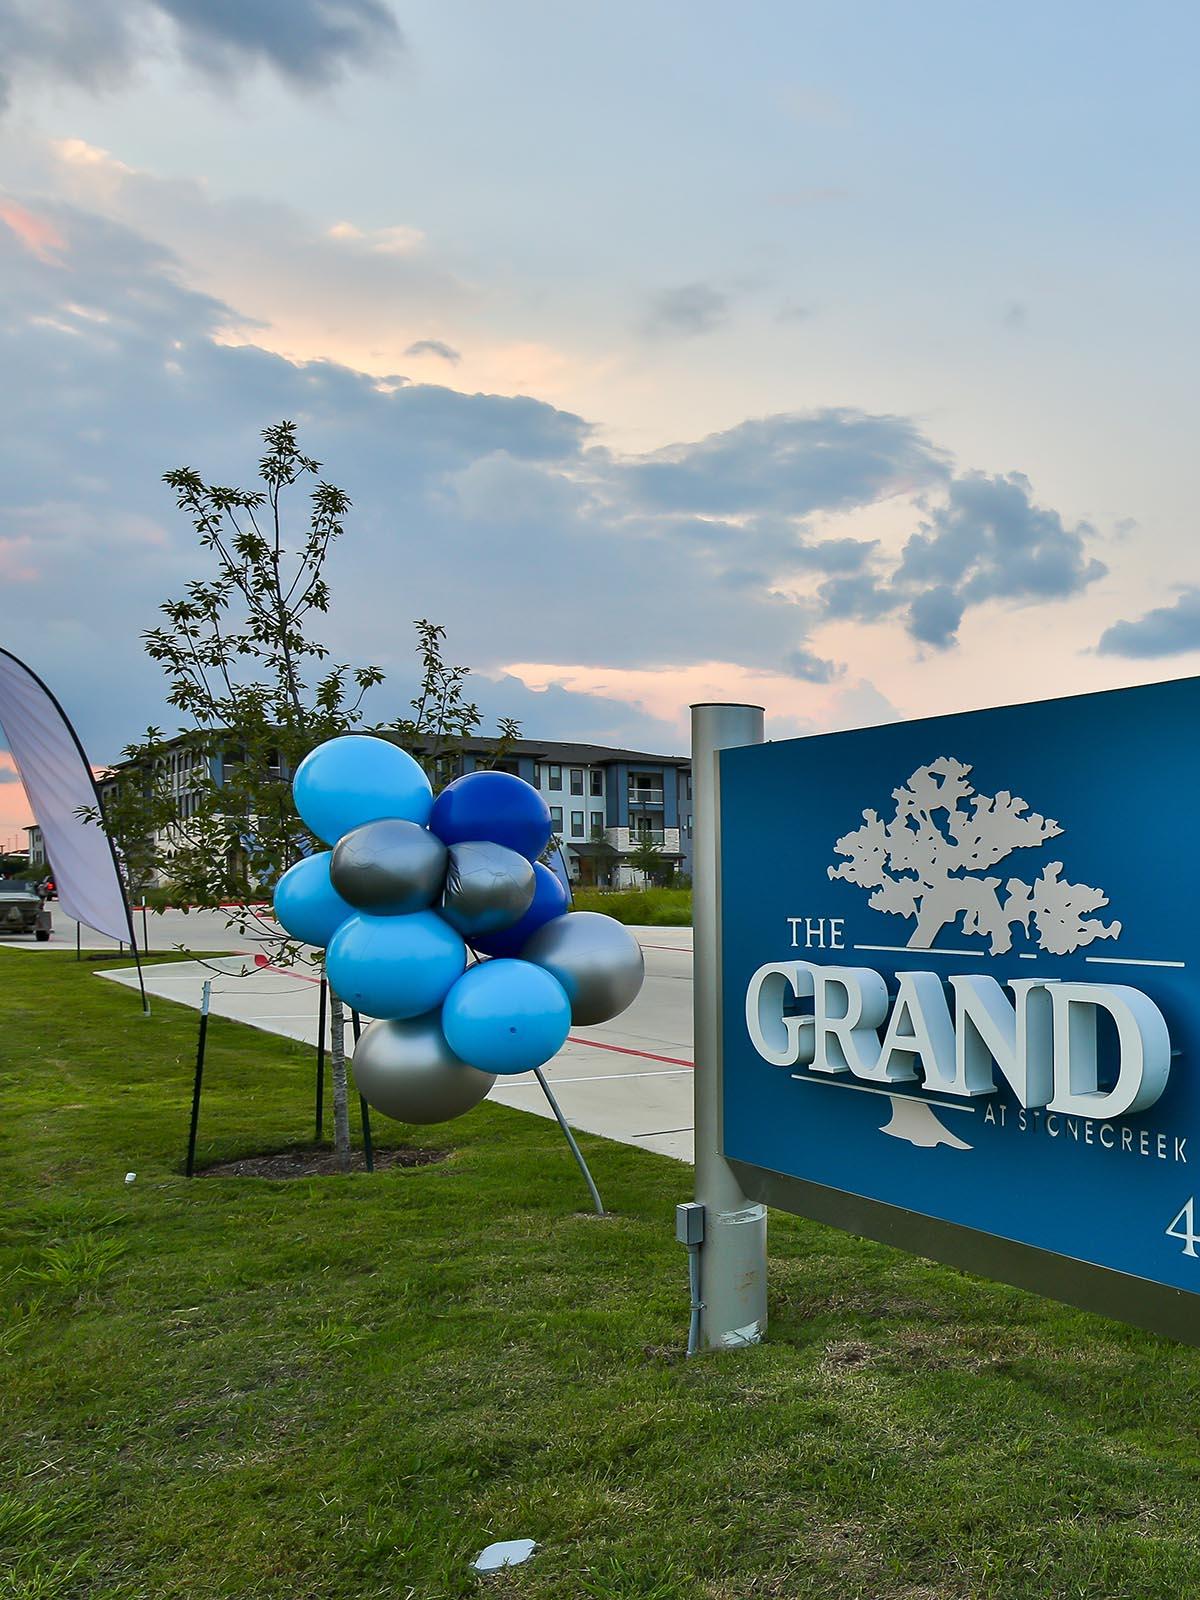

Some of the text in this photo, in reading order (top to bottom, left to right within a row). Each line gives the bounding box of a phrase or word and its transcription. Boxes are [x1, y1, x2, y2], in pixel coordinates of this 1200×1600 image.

[787, 917, 845, 950] THE
[745, 961, 1171, 1119] GRAND
[983, 1103, 1007, 1127] AT
